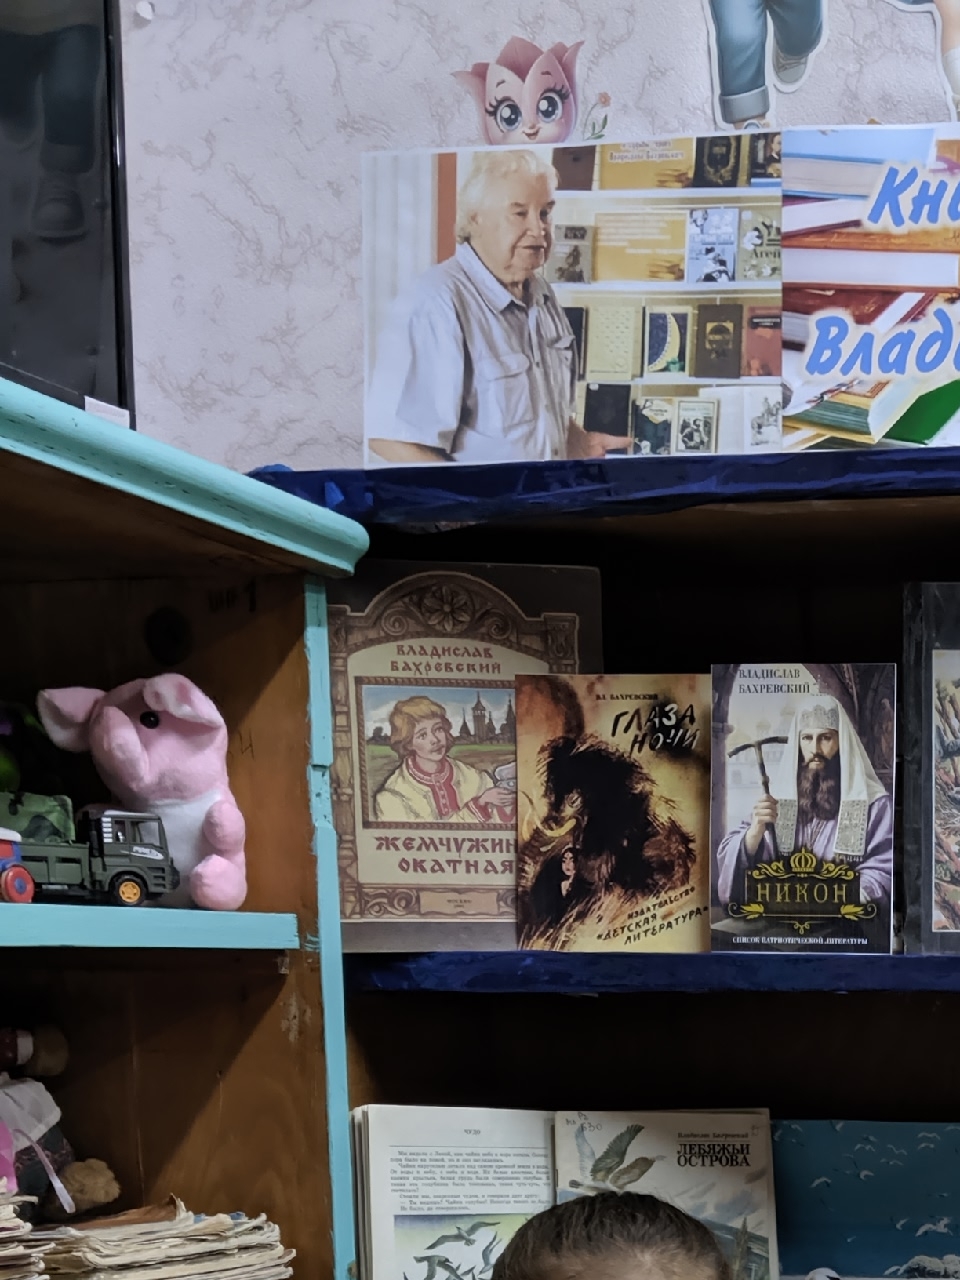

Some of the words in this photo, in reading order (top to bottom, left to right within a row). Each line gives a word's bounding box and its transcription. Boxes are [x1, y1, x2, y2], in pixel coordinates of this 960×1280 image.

[396, 644, 493, 659] ВЛАДИСЛАВ
[390, 660, 501, 675] БАХРЕВСКИЙ
[739, 668, 800, 679] ВЛАДИСЛАВ
[739, 681, 810, 694] БАХРЕВСКИЙ
[611, 703, 696, 737] ГЛАЗА
[630, 728, 700, 755] НОЧИ
[397, 857, 514, 875] ОКАТНАЯ
[756, 883, 848, 903] НИКОН
[627, 886, 695, 920] ИЗДАТЕЛЬСТВО
[732, 936, 760, 944] СПИСОК
[677, 1144, 751, 1156] ЛЕБЯЖЬИ
[677, 1155, 751, 1167] ОСТРОВА
